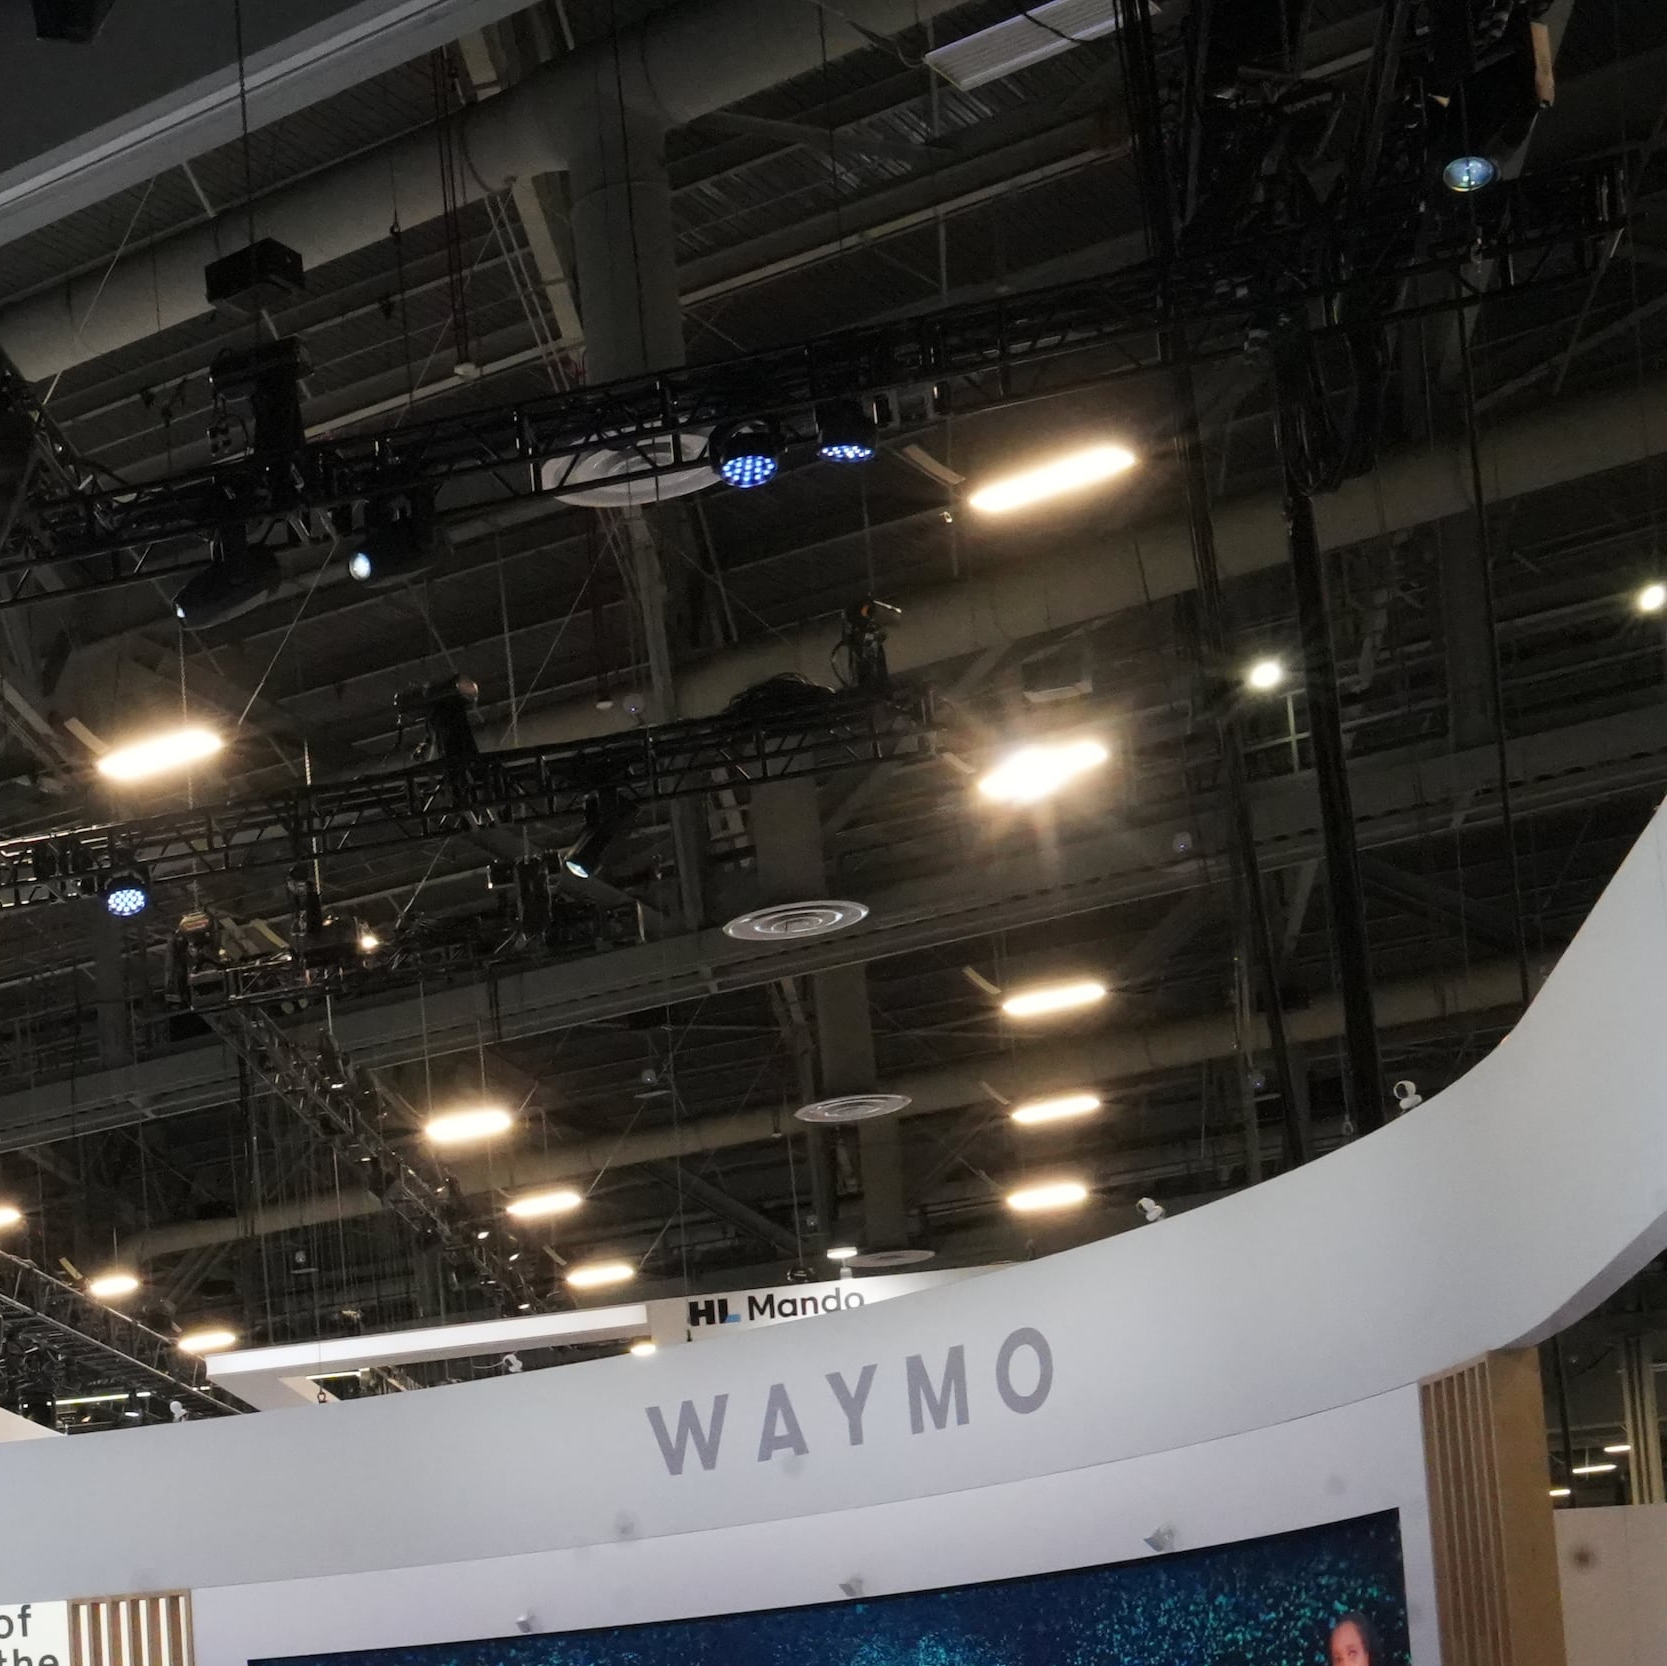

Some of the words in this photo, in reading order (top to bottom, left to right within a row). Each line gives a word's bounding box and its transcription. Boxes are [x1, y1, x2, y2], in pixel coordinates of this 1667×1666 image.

[689, 1298, 741, 1326] HL
[748, 1288, 865, 1321] Mando
[645, 1327, 1053, 1476] WAYMO
